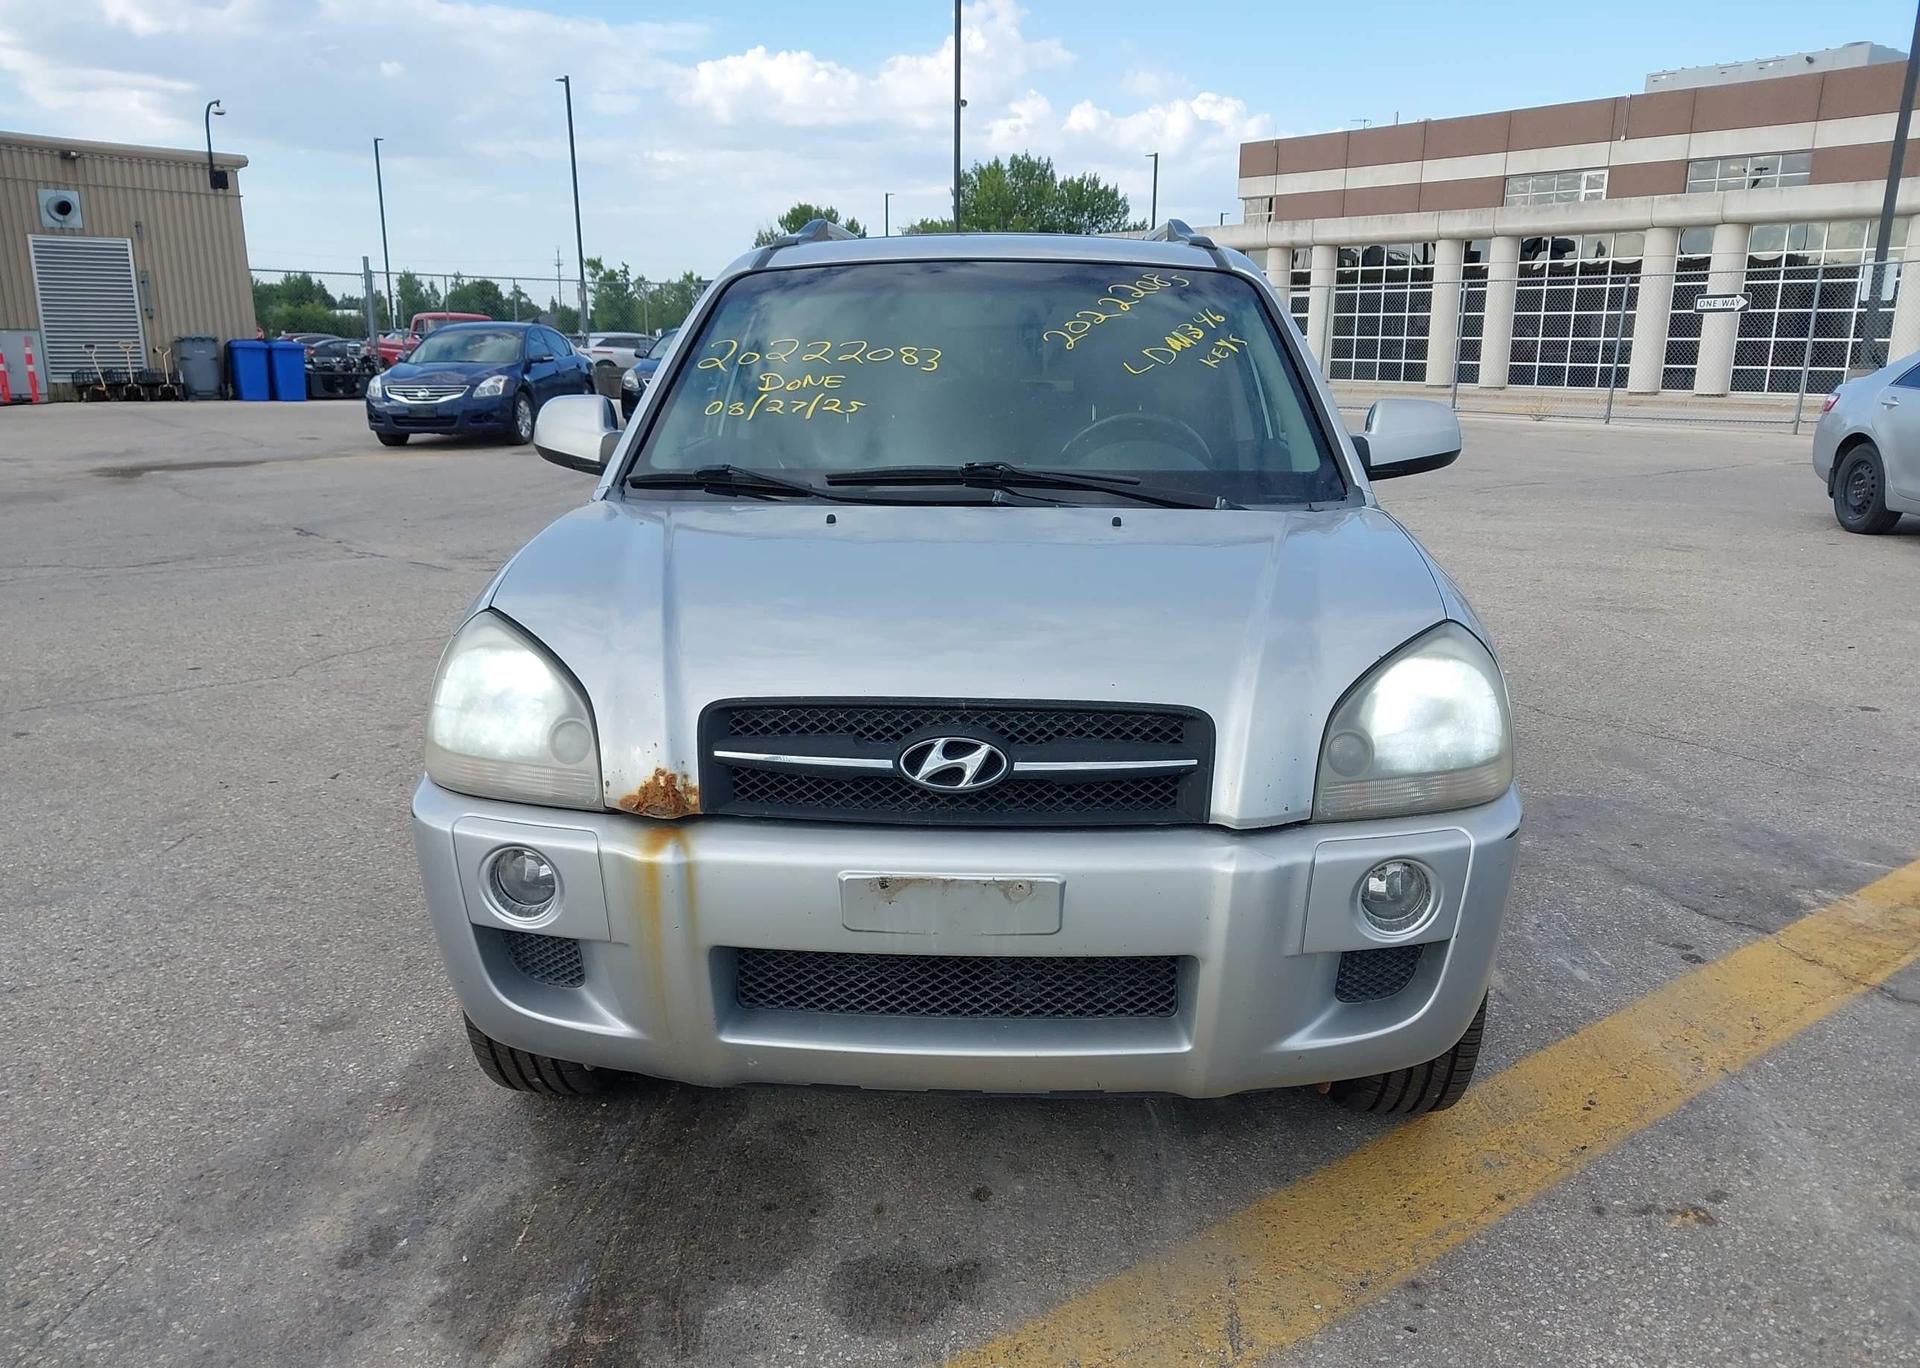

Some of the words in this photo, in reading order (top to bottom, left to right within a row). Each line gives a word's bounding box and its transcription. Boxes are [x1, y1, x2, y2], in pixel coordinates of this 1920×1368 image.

[1699, 299, 1718, 308] ONE
[1721, 298, 1741, 308] WAY
[697, 338, 942, 372] 20222083
[704, 392, 867, 422] 08/27/25
